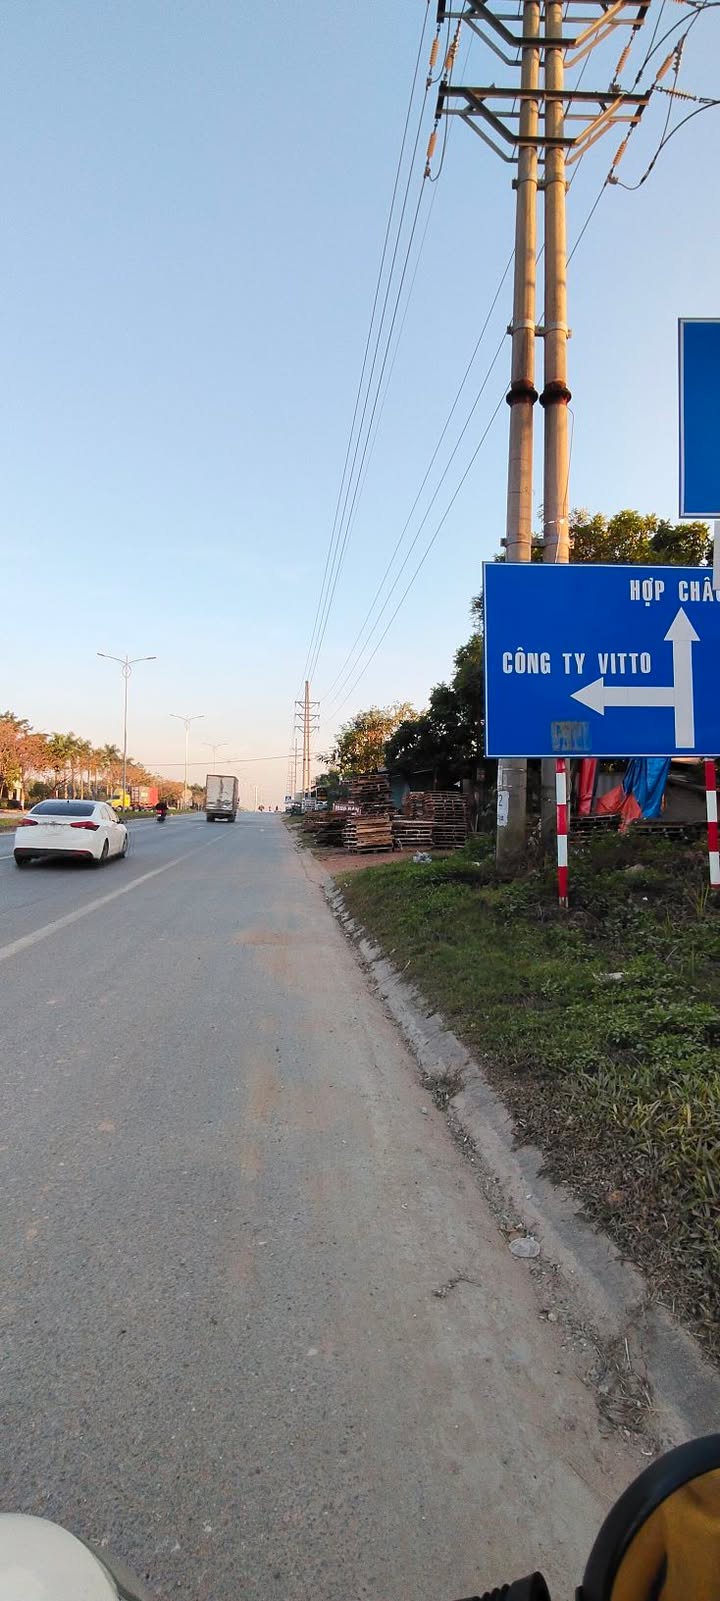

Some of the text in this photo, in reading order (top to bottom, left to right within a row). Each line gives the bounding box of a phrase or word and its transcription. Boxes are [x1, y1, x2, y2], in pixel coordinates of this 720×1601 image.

[629, 577, 665, 607] HỢP
[502, 646, 652, 674] CÔNG TY VITTO
